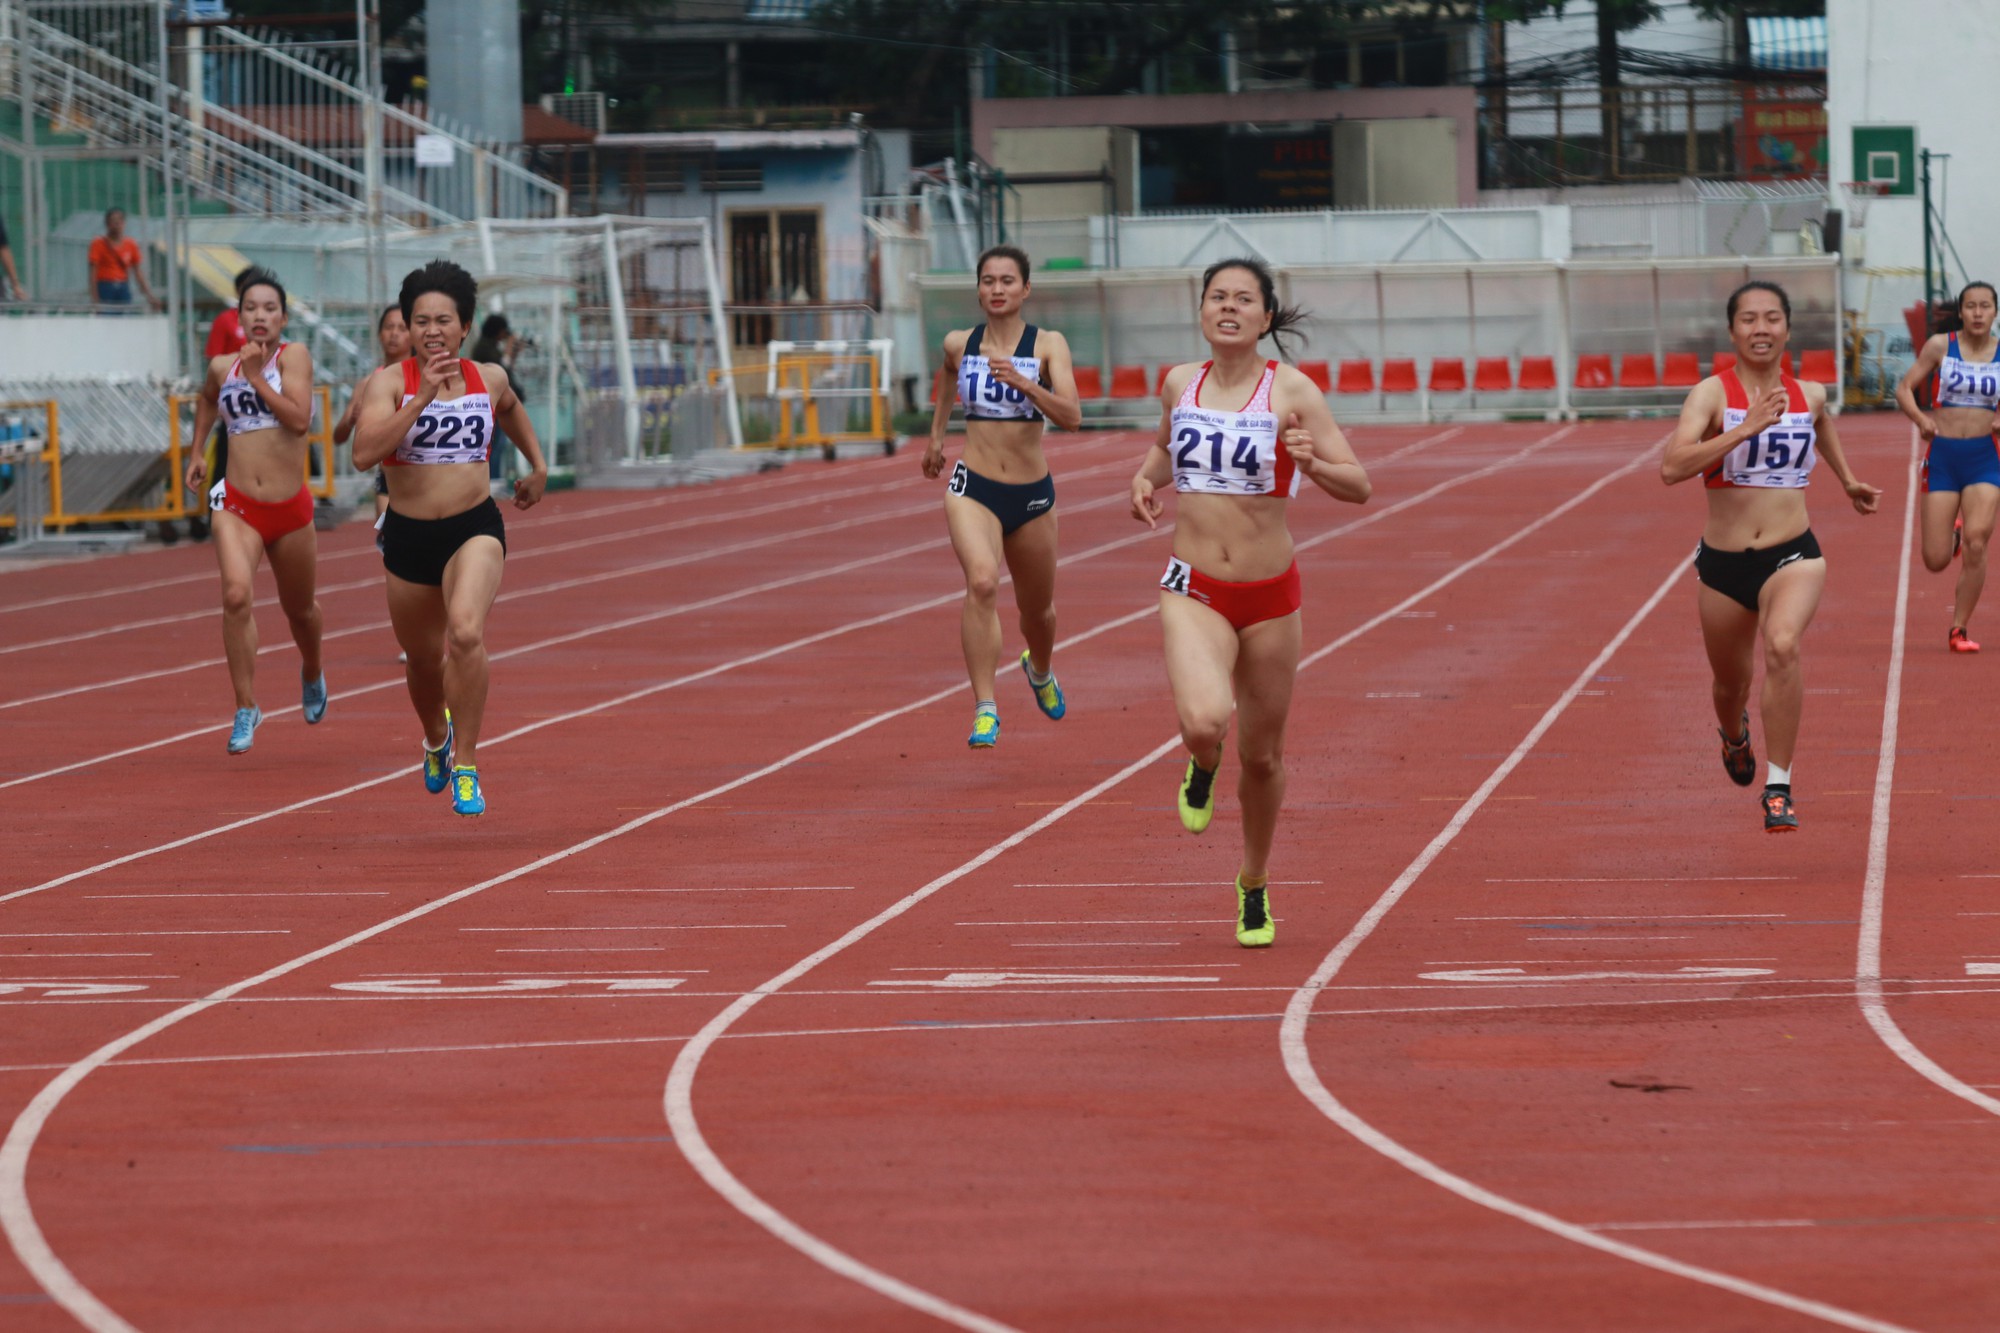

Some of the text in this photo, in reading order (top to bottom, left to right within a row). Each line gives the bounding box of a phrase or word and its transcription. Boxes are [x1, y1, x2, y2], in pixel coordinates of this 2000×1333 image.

[1947, 371, 1996, 397] 210
[412, 415, 485, 448] 223
[1177, 427, 1260, 476] 214
[1744, 432, 1811, 469] 157
[331, 976, 686, 993] 5
[1418, 966, 1776, 982] 3
